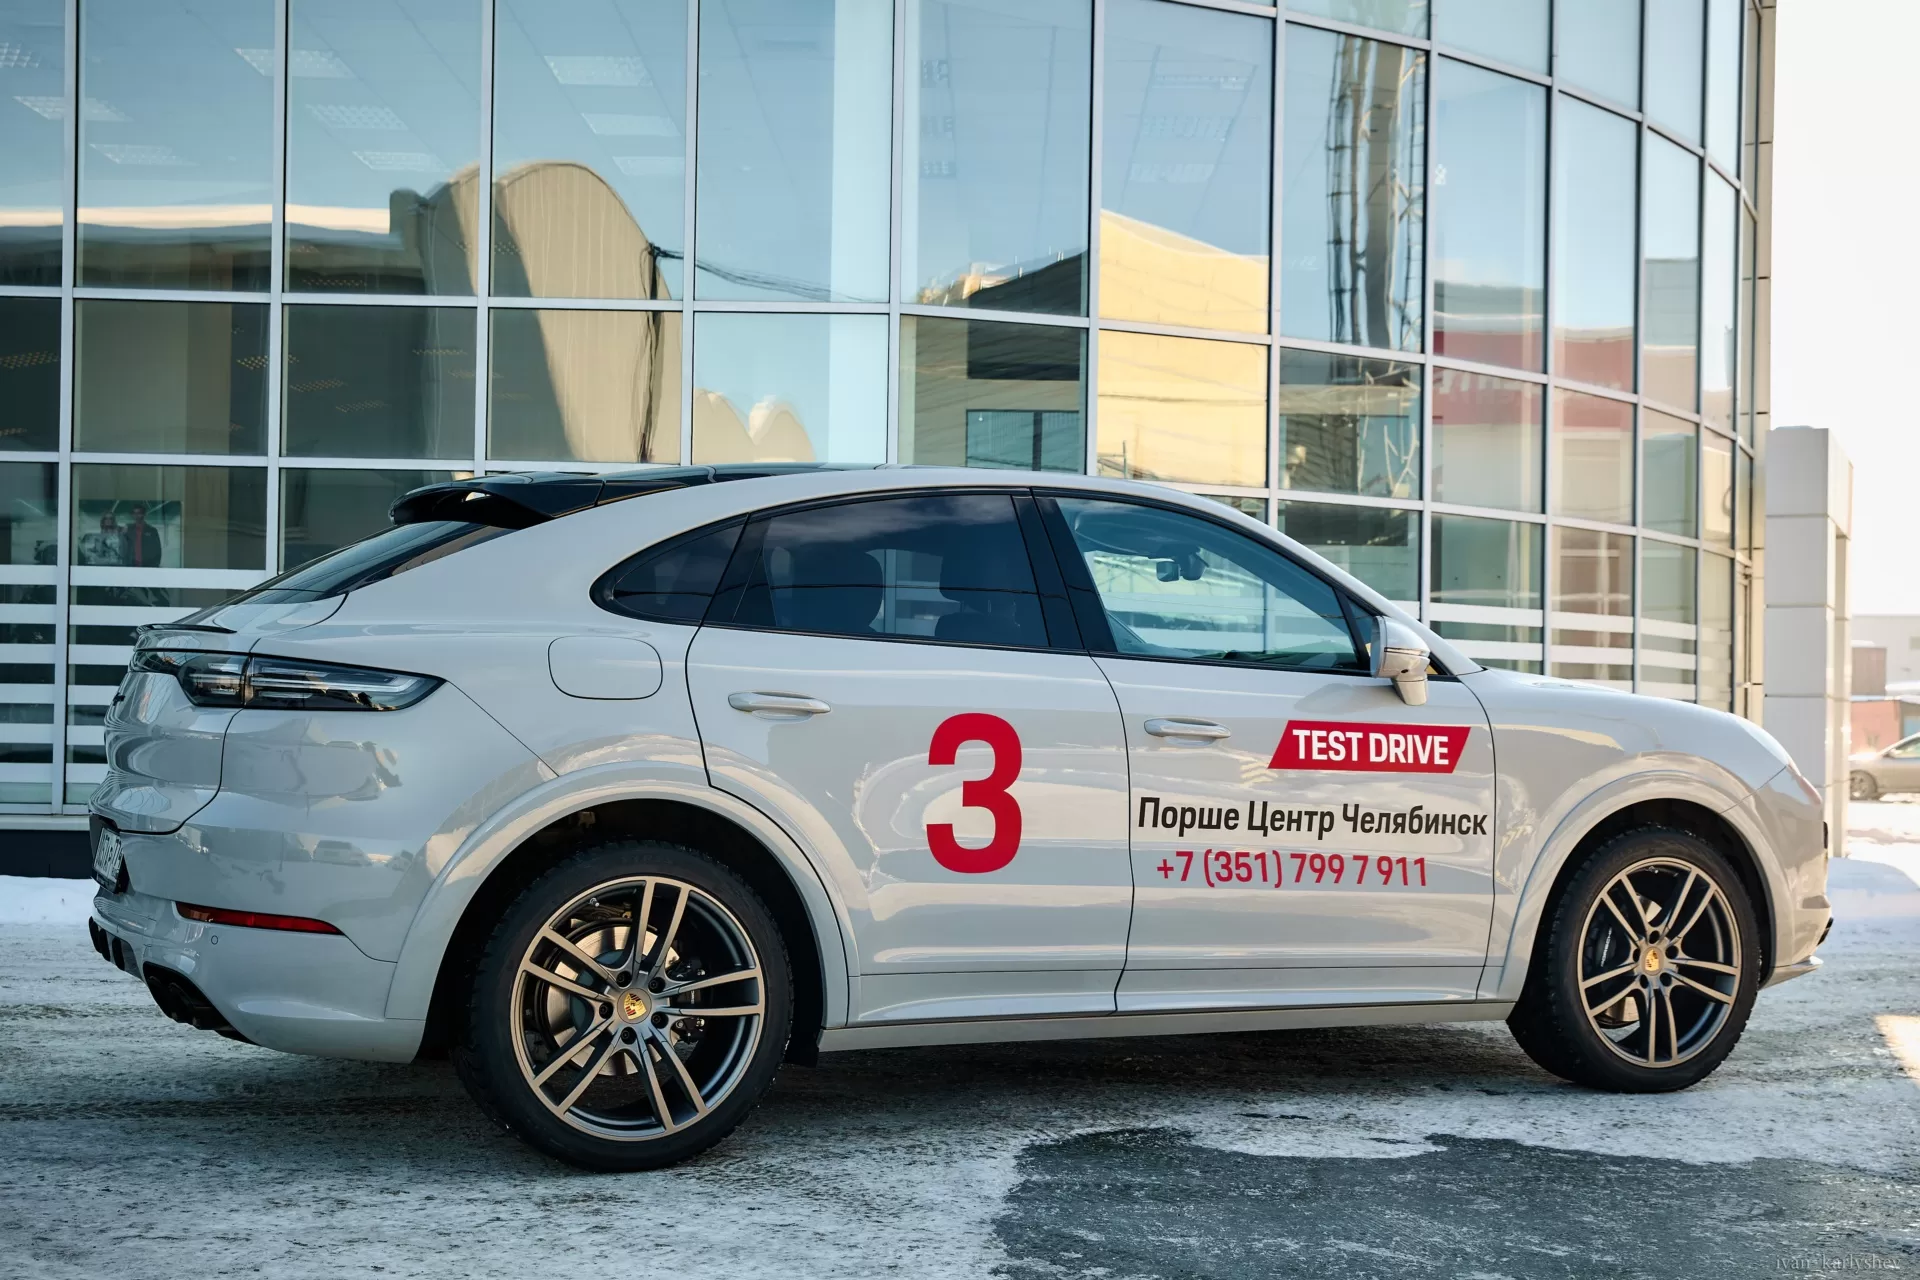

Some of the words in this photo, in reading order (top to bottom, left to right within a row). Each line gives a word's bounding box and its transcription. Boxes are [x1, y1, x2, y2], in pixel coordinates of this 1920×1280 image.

[1292, 729, 1364, 762] TEST
[1368, 732, 1449, 765] DRIVE
[926, 712, 1023, 874] 3
[1138, 796, 1240, 837] Порше
[1247, 800, 1335, 841] Центр
[1342, 803, 1488, 836] Челябинск
[1156, 850, 1194, 882] +7
[1203, 848, 1283, 889] (351)
[1289, 852, 1345, 884] 799
[1352, 854, 1369, 885] 7
[1375, 855, 1427, 887] 911
